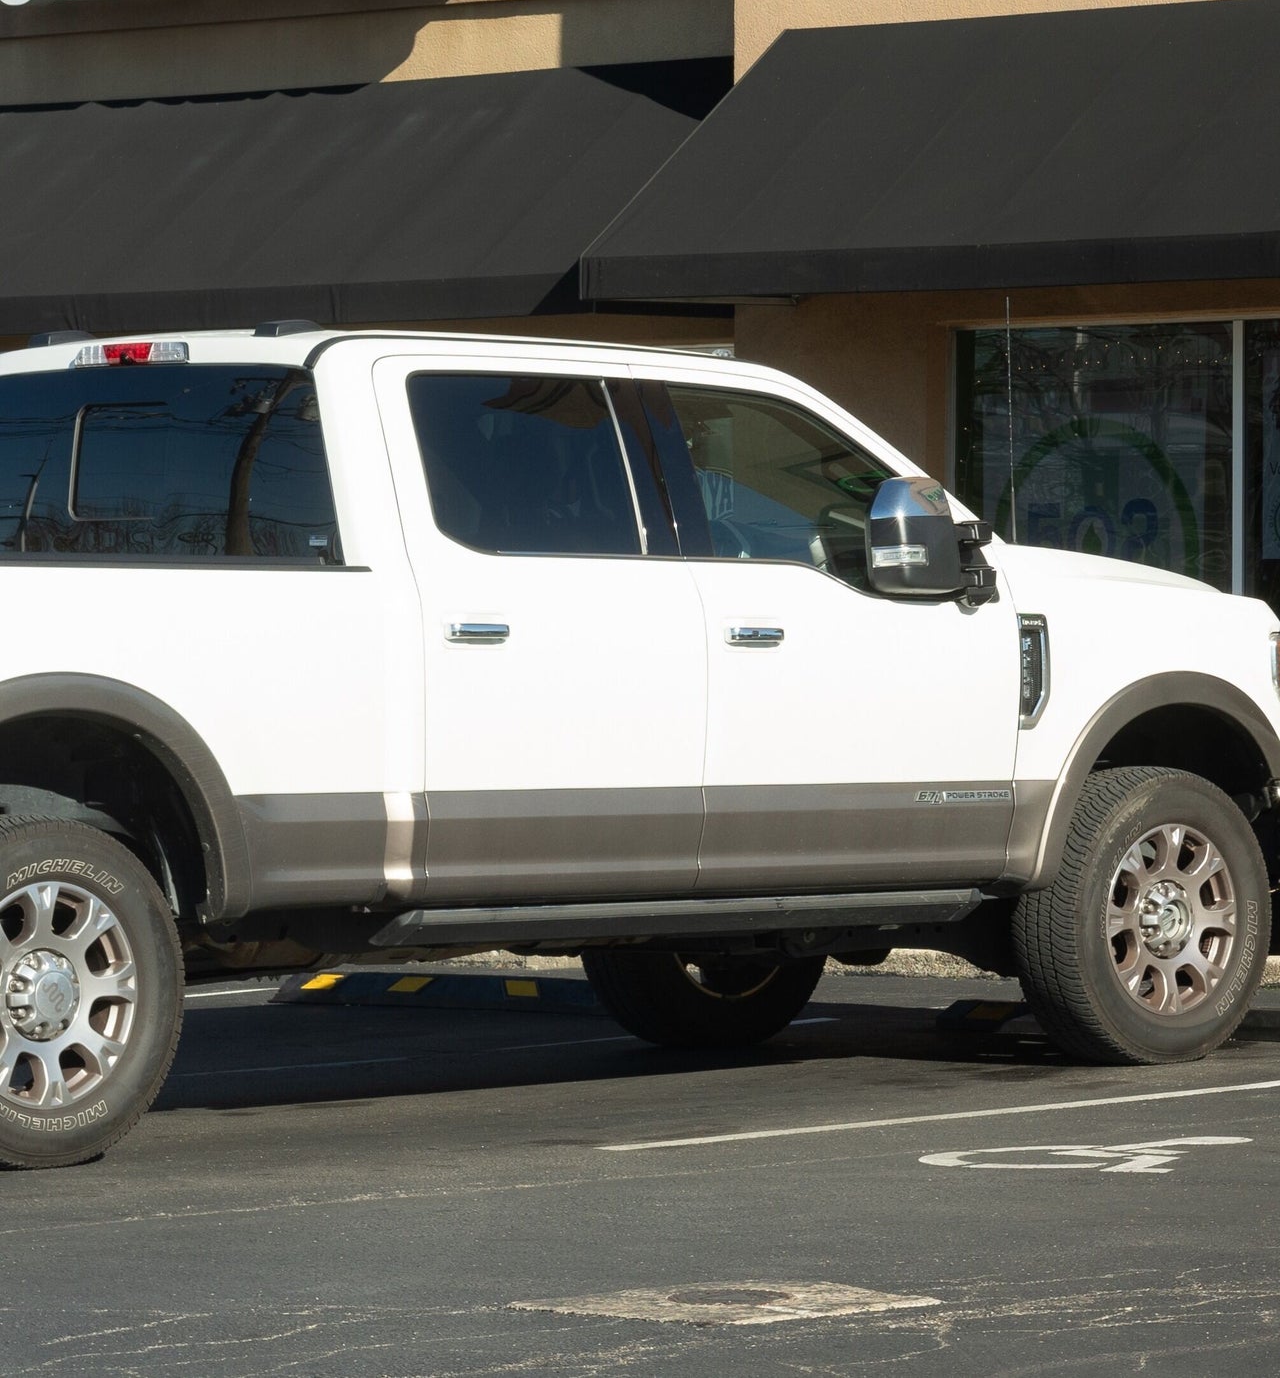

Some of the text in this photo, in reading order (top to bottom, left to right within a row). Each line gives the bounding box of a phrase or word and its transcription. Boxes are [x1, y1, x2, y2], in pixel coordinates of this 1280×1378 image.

[977, 791, 1010, 799] STROKE
[6, 858, 126, 895] MICHELIN
[1215, 900, 1258, 1017] MICHELIN
[0, 1099, 109, 1132] MICHELIN
